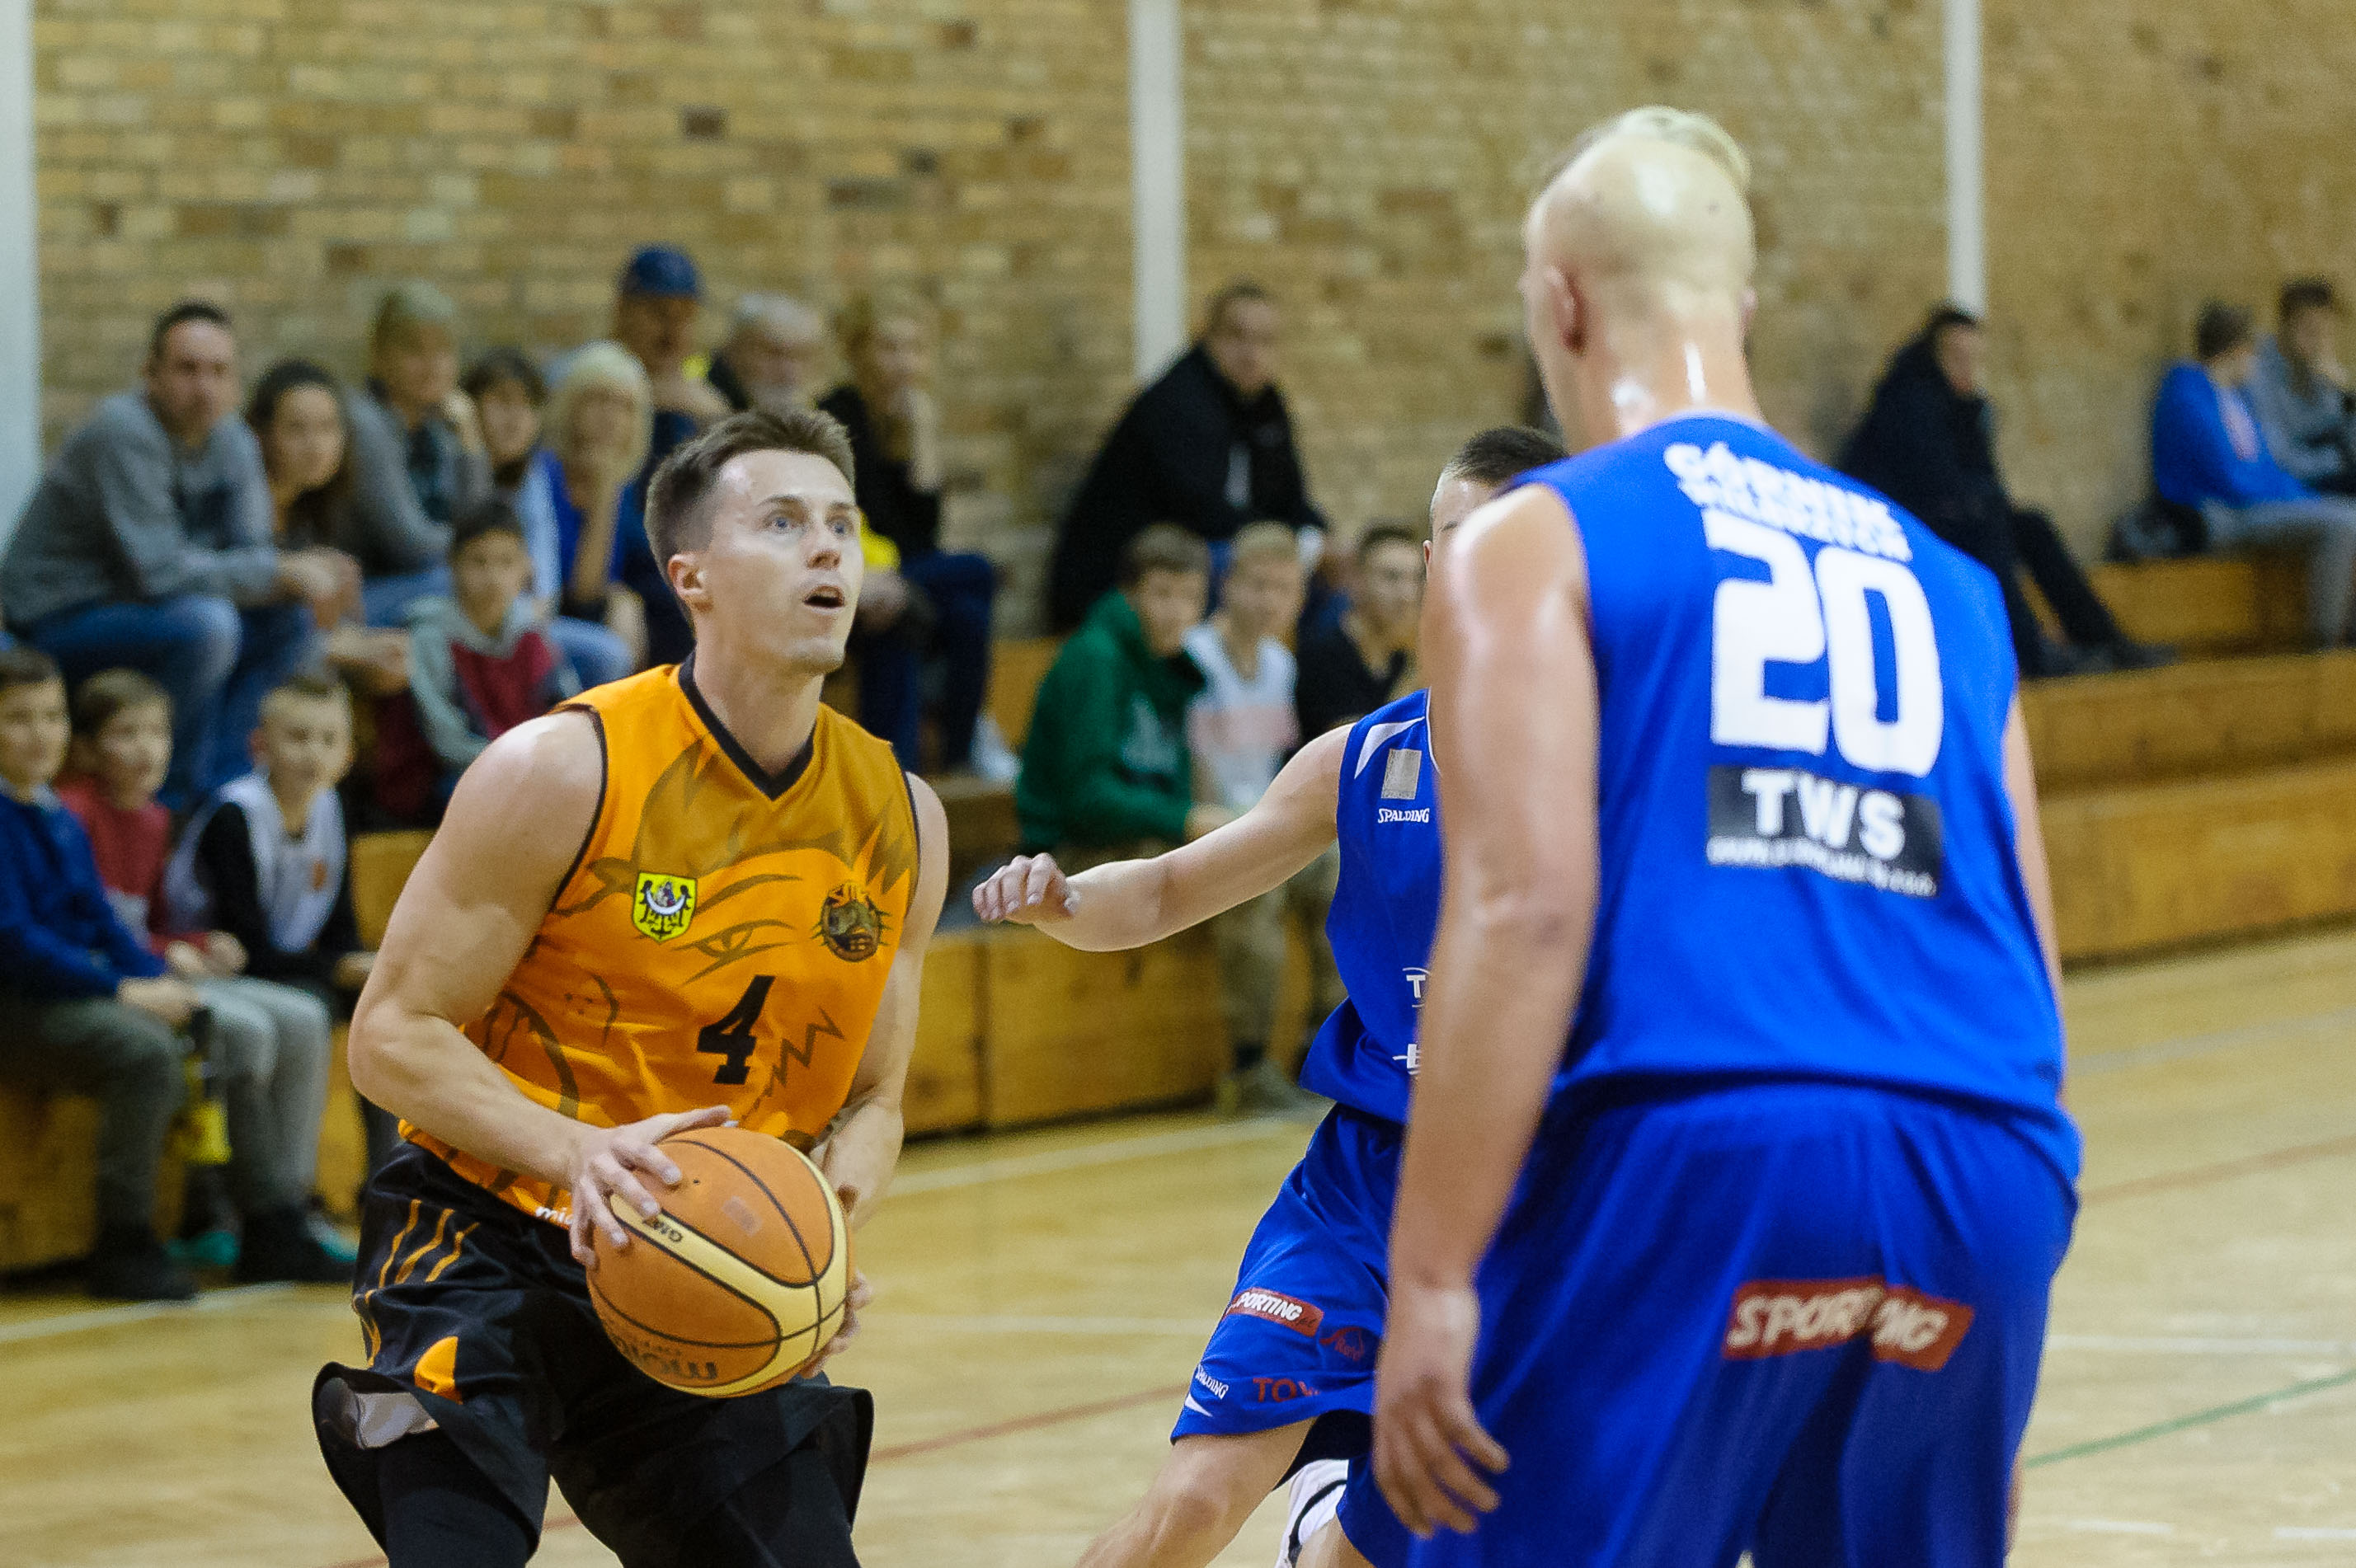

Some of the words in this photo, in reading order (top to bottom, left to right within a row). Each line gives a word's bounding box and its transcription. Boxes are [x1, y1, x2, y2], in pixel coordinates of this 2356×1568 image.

[1701, 508, 1945, 778] 20
[1377, 807, 1430, 824] SPALDING
[1741, 768, 1906, 861] TWS
[695, 975, 777, 1085] 4
[1232, 1291, 1303, 1322] PORTING
[1726, 1285, 1949, 1354] SPORNG
